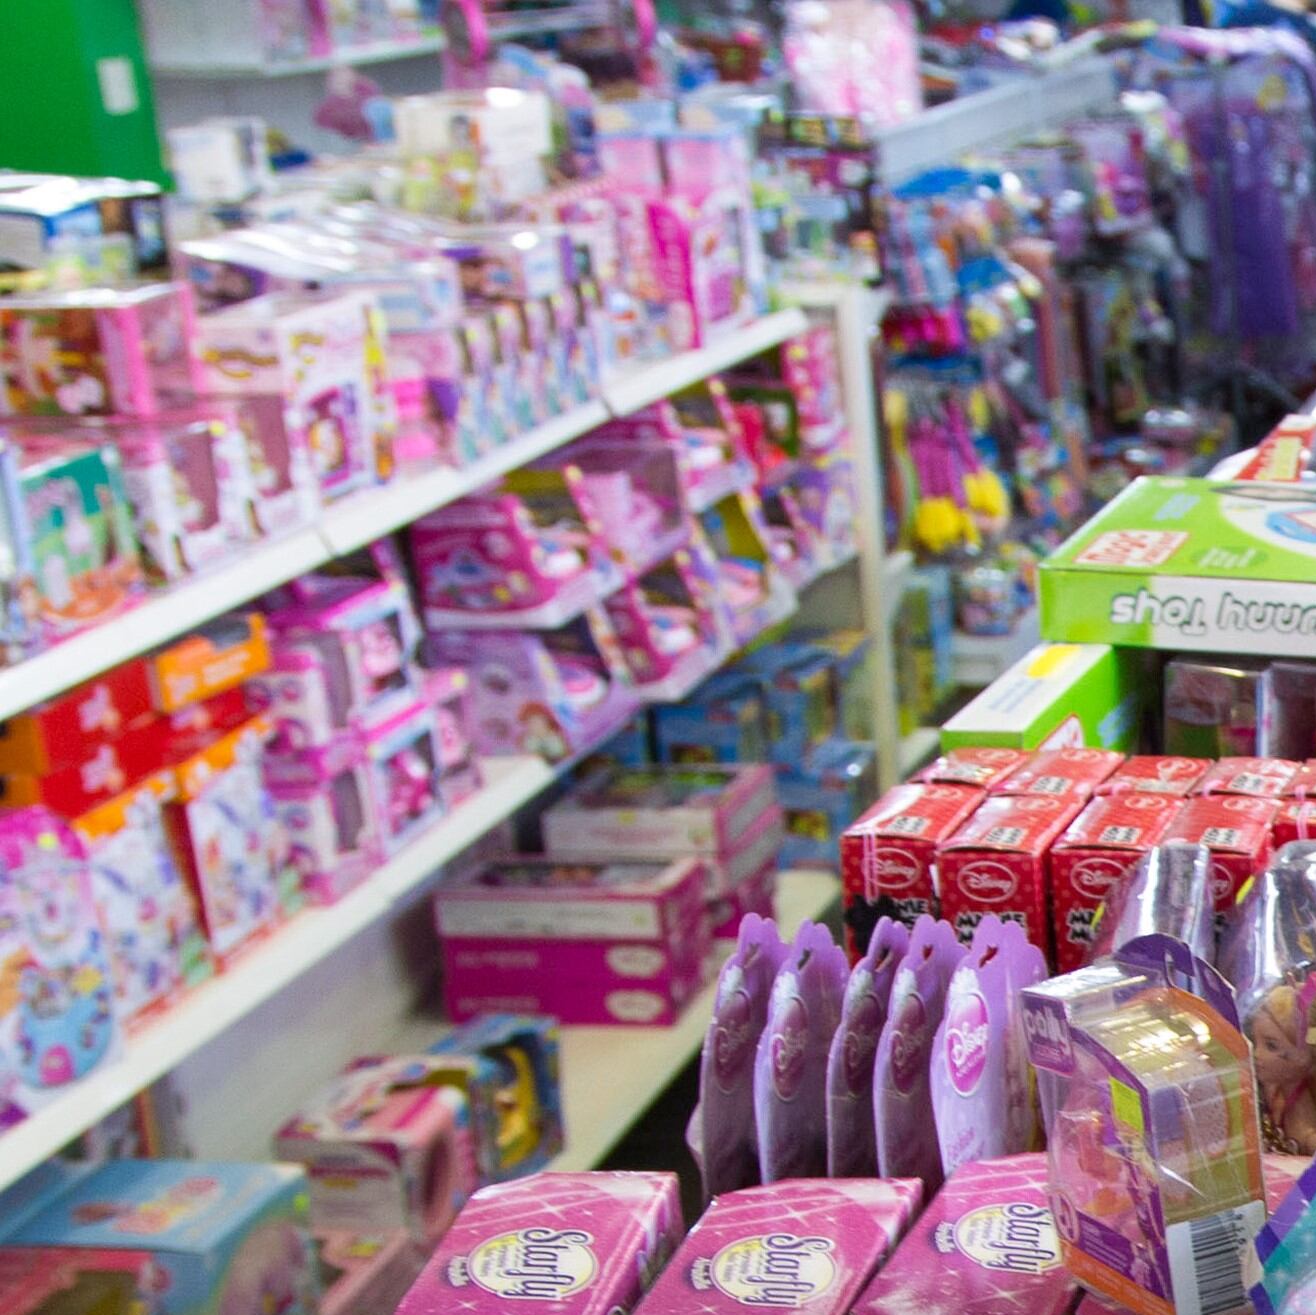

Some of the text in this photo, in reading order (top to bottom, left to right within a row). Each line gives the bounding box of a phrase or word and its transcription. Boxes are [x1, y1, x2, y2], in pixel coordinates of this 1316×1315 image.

[1111, 588, 1206, 636] Toys
[503, 1228, 589, 1298] Starfly
[745, 1235, 831, 1306] Starfly
